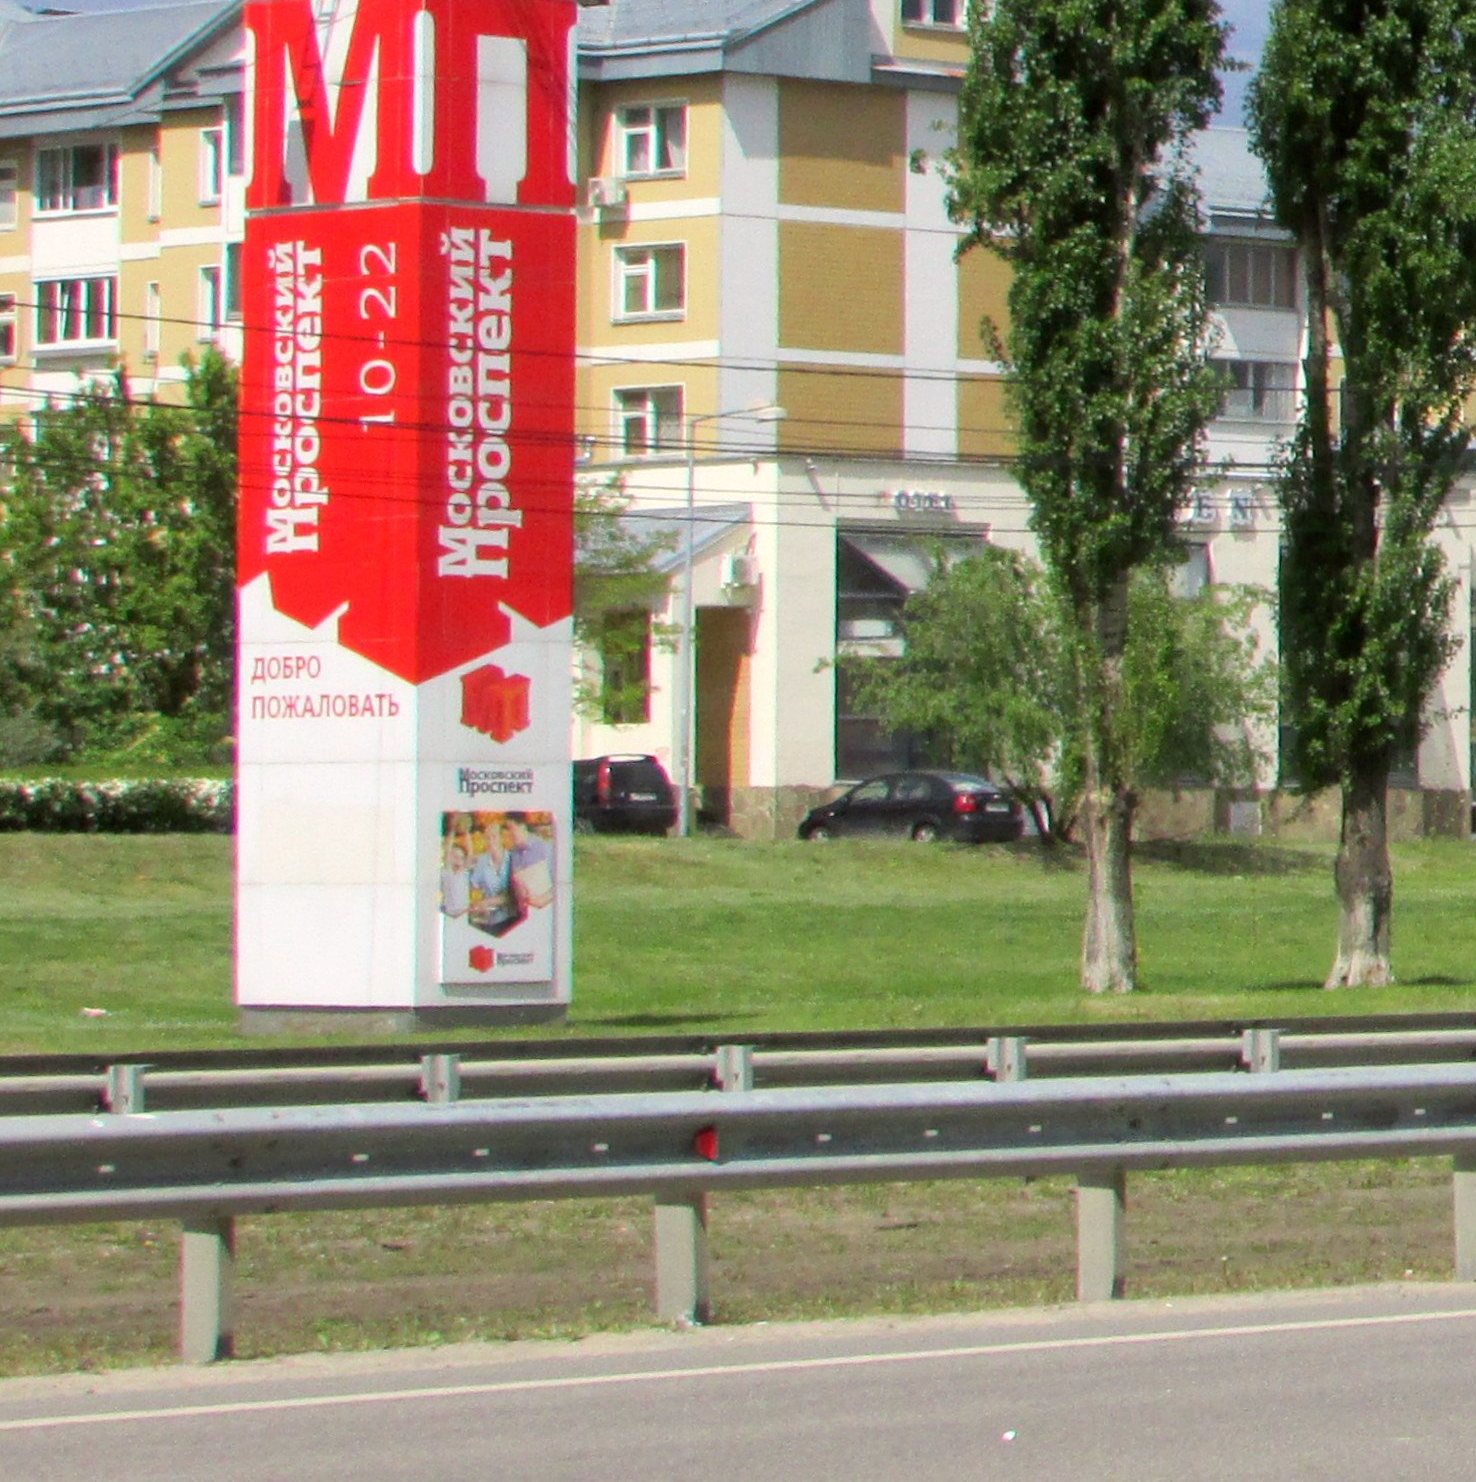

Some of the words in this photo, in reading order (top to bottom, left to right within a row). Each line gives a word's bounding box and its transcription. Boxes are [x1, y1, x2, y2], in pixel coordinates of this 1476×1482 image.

[266, 242, 295, 554] Московский
[293, 240, 329, 553] Проспект
[358, 241, 397, 432] 10-22
[438, 227, 476, 578] Московский
[476, 228, 523, 580] Проспект
[251, 655, 321, 684] ДОБРО
[251, 693, 400, 719] ПОЖАЛОВАТЬ
[459, 781, 533, 797] Проспект
